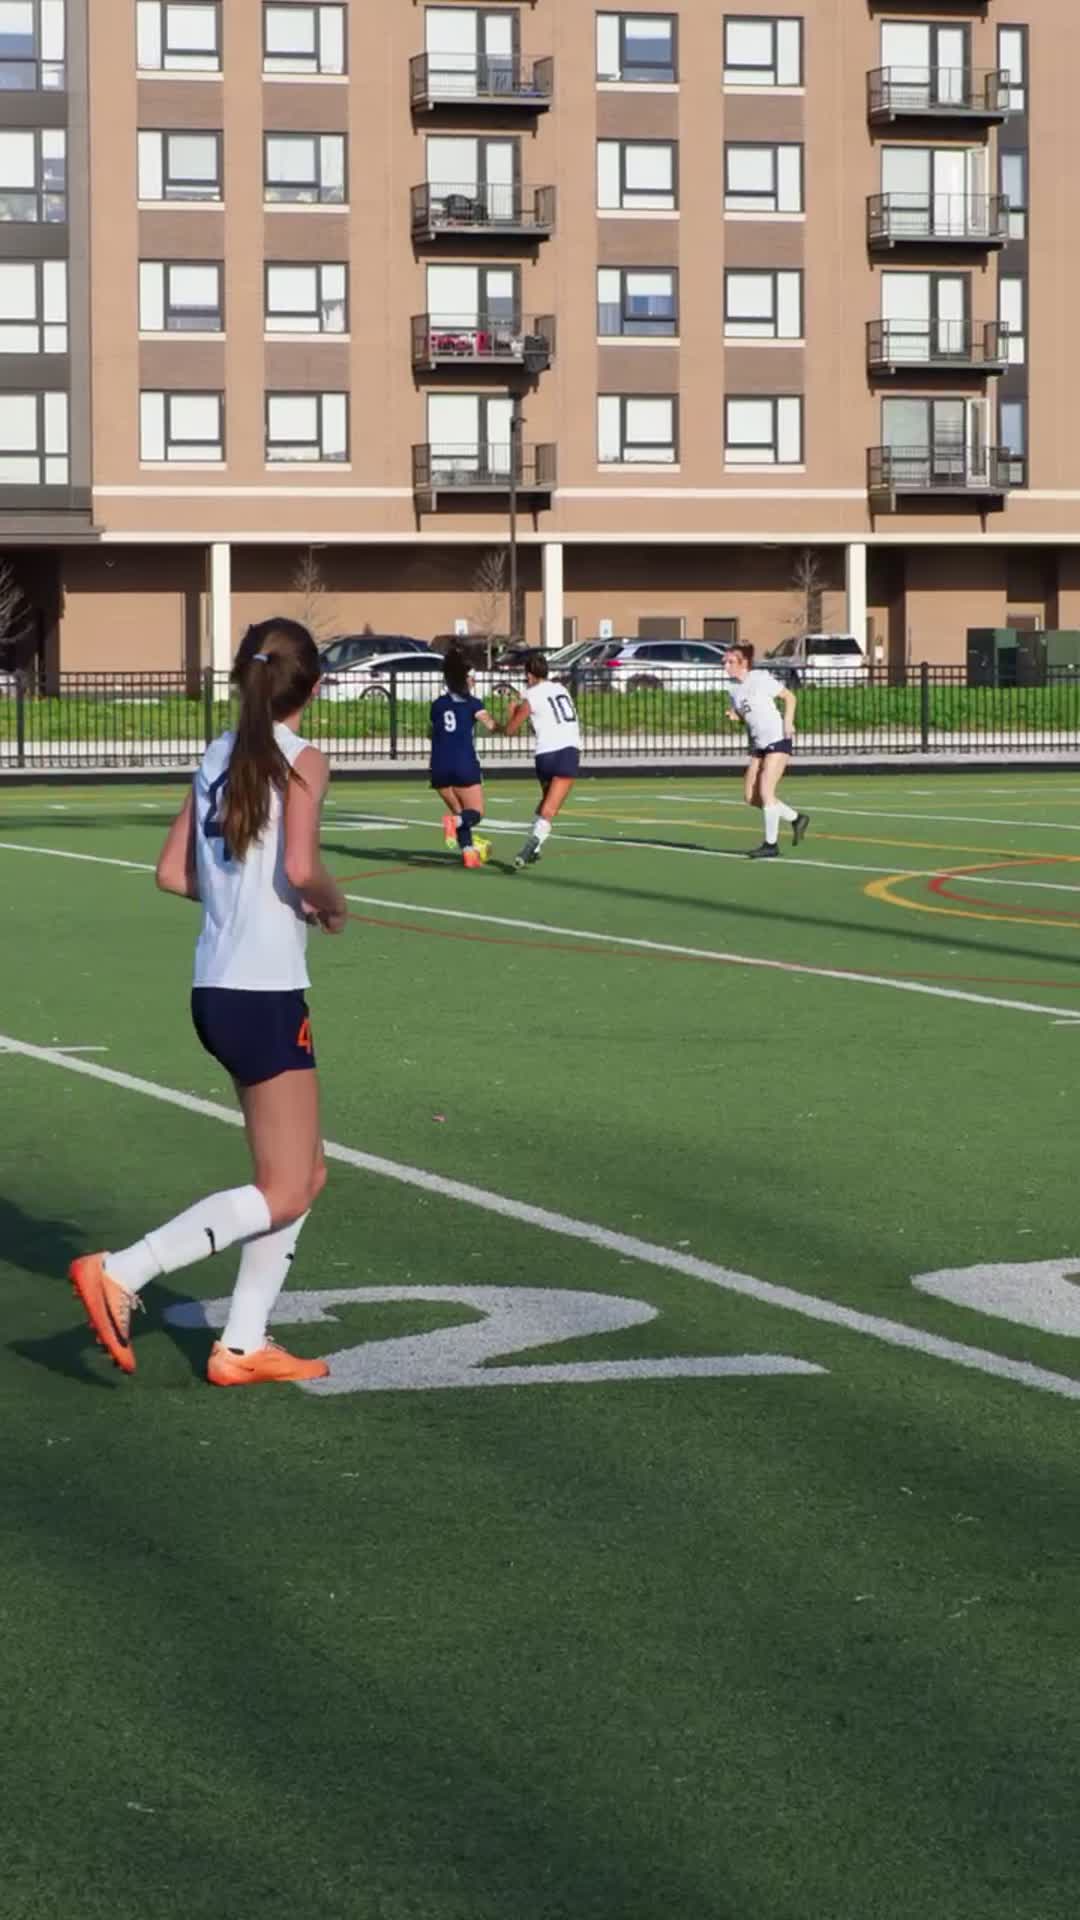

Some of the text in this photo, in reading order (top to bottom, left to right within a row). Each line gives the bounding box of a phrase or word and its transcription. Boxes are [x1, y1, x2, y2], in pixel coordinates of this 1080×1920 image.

[443, 710, 457, 732] 9
[547, 694, 577, 724] 10
[297, 1016, 314, 1055] 4
[162, 1285, 830, 1396] 2
